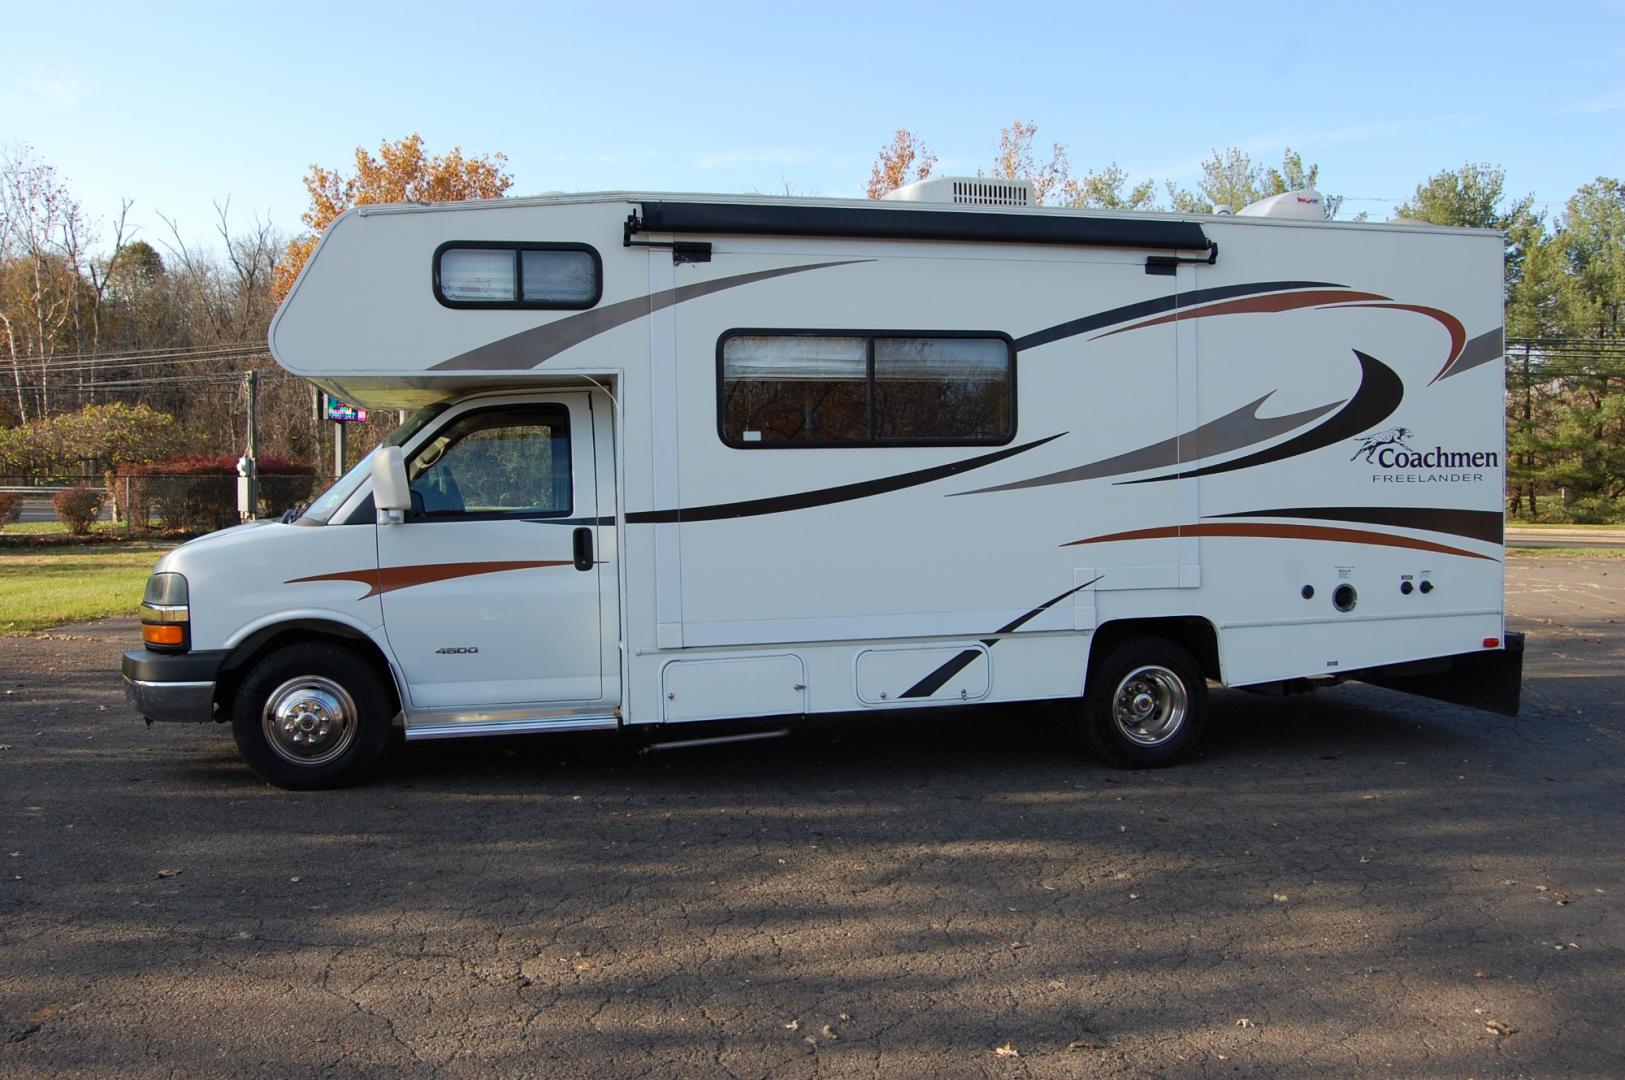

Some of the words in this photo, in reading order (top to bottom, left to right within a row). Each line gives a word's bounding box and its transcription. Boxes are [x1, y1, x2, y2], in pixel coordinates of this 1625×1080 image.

[1379, 446, 1498, 468] Coachmen
[1372, 473, 1483, 483] FREELANDER
[435, 647, 479, 655] 4500
